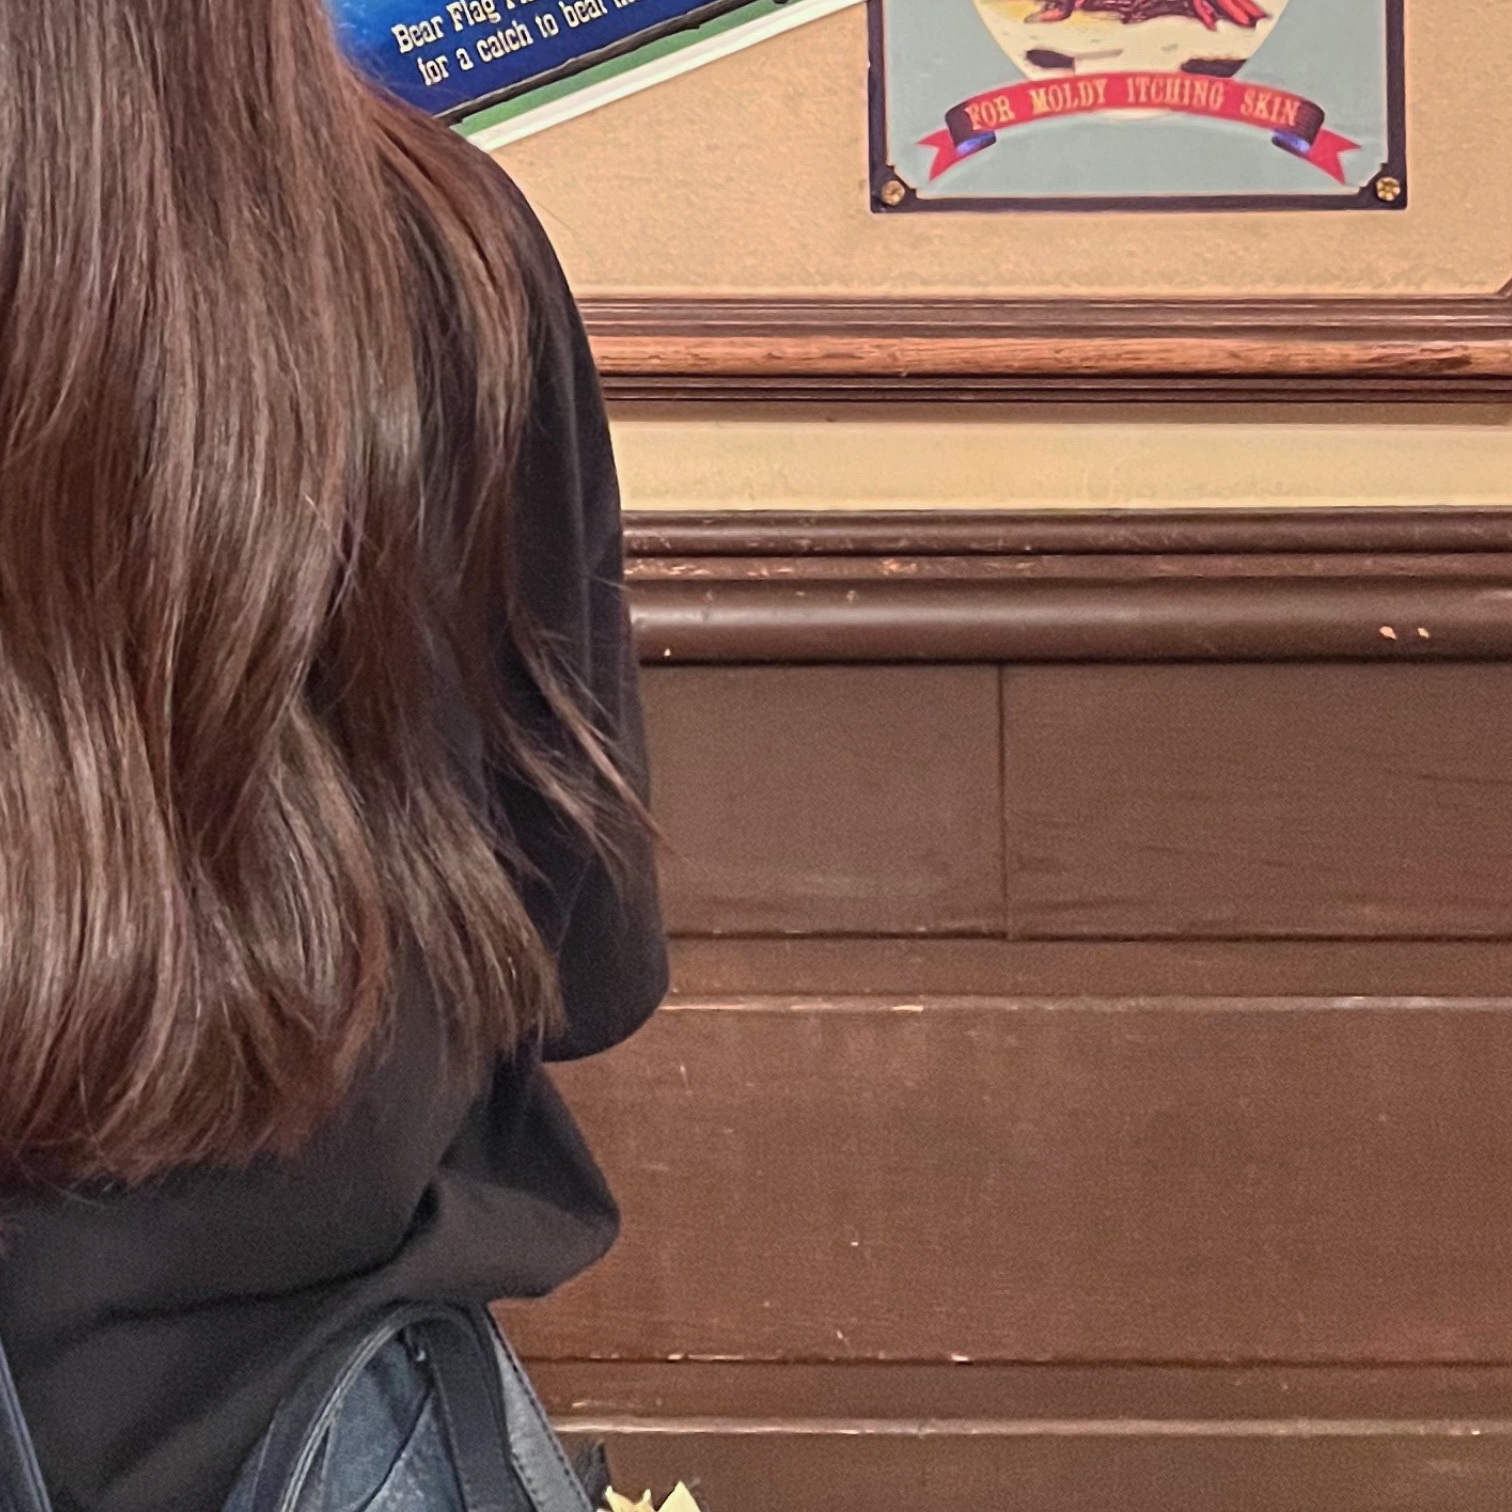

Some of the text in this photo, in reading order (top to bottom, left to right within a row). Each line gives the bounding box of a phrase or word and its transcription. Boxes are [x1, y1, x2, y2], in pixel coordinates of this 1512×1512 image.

[390, 14, 445, 55] Bear
[416, 55, 450, 87] for
[456, 47, 475, 72] a
[475, 19, 535, 64] catch
[534, 11, 559, 40] to
[963, 74, 1302, 132] FOR MOLDY ITCHING SKIN
